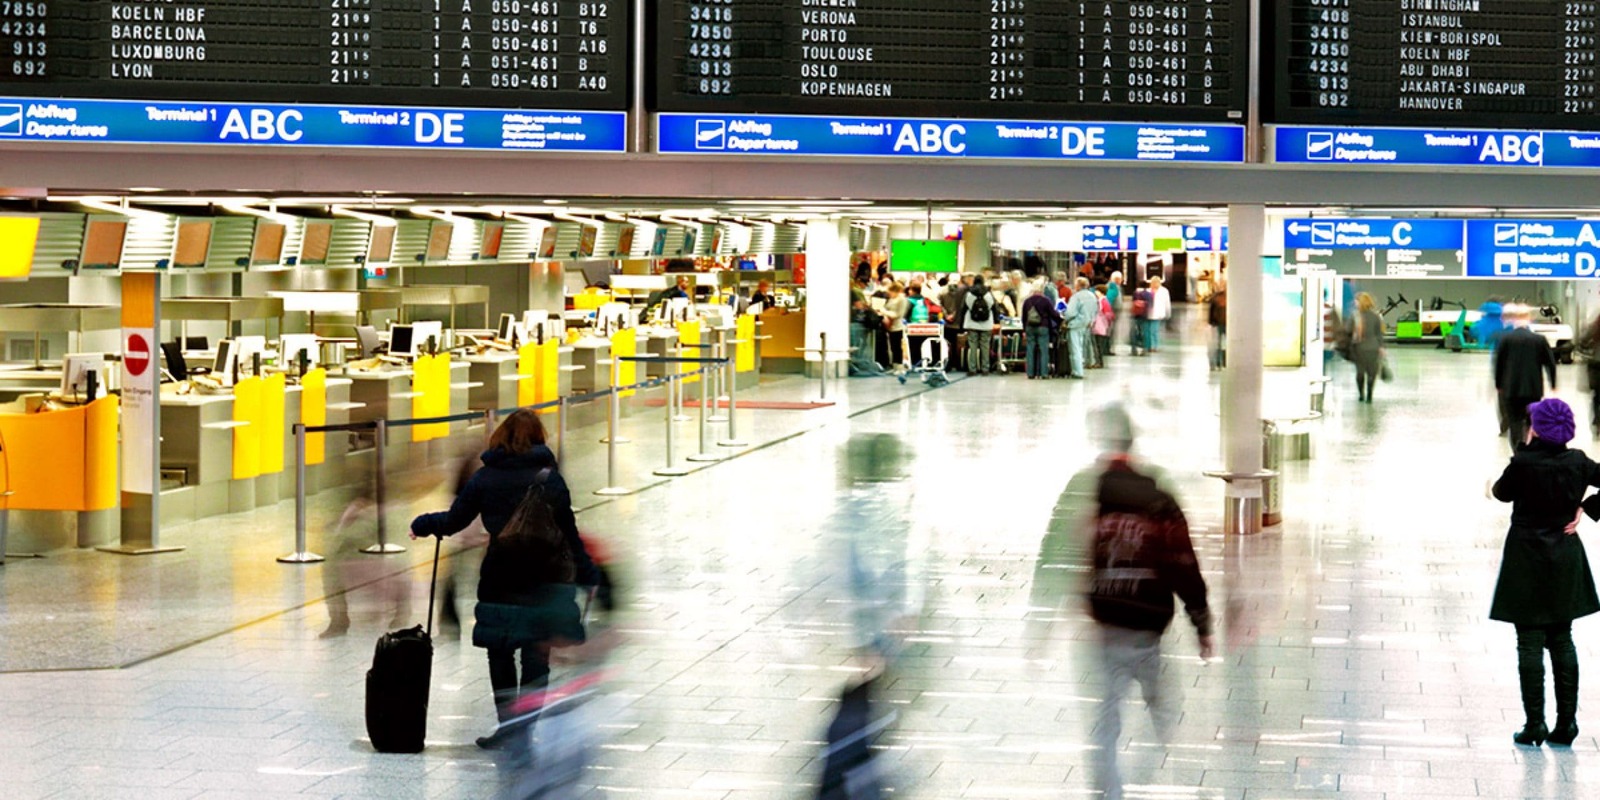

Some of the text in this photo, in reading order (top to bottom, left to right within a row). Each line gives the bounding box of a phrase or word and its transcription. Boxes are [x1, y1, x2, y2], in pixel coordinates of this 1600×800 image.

[3, 2, 46, 15] 7850
[112, 6, 163, 20] KOELN
[176, 8, 205, 22] HBF
[434, 17, 439, 29] 1
[462, 17, 471, 30] A
[492, 18, 557, 33] 050-461
[580, 21, 597, 35] T6
[435, 0, 439, 10] 1
[462, 0, 471, 11] A
[492, 1, 557, 15] 050-461
[580, 3, 607, 16] B12
[1080, 4, 1084, 14] 1
[1104, 4, 1111, 15] A
[1130, 5, 1186, 18] 050-461
[1205, 8, 1212, 19] A
[1321, 9, 1349, 23] 408
[1403, 14, 1462, 27] ISTANBUL
[691, 7, 732, 21] 3416
[802, 11, 855, 24] VERONA
[1080, 21, 1084, 32] 1
[1104, 21, 1111, 32] A
[1130, 22, 1185, 35] 050-461
[1205, 25, 1212, 36] A
[2, 22, 45, 36] 4234
[112, 25, 205, 40] BARCELONA
[434, 35, 439, 48] 1
[462, 36, 471, 48] A
[492, 37, 557, 51] 050-461
[579, 40, 606, 53] A16
[691, 25, 731, 39] 7850
[802, 28, 846, 42] PORTO
[1080, 38, 1084, 49] 1
[1104, 39, 1111, 49] A
[1129, 39, 1185, 52] 050-461
[1205, 42, 1212, 53] A
[1311, 26, 1348, 39] 3416
[1401, 31, 1501, 45] KIEW-BORISPOL
[14, 42, 46, 55] 913
[434, 54, 439, 66] 1
[461, 54, 470, 67] A
[492, 55, 557, 70] 051-461
[579, 58, 587, 71] B
[690, 43, 731, 57] 4234
[802, 46, 872, 60] TOULOUSE
[1079, 55, 1083, 66] 1
[1103, 56, 1111, 67] A
[1129, 57, 1185, 69] 050-461
[1205, 59, 1212, 70] A
[1311, 42, 1348, 56] 7850
[1401, 48, 1439, 59] KOELN
[1448, 49, 1469, 60] HBF
[13, 61, 45, 75] 692
[112, 63, 152, 77] LYON
[434, 72, 439, 85] 1
[461, 73, 470, 85] A
[492, 73, 557, 88] 050-461
[579, 76, 606, 89] A40
[701, 61, 731, 75] 913
[801, 64, 837, 77] OSLO
[1080, 72, 1083, 83] 1
[1103, 73, 1110, 84] A
[1129, 73, 1185, 86] 050-461
[1205, 76, 1211, 87] B
[1310, 60, 1347, 72] 4234
[1400, 64, 1423, 76] ABU
[1432, 65, 1469, 77] DHABI
[700, 79, 730, 93] 692
[801, 82, 891, 96] KOPENHAGEN
[1079, 90, 1083, 100] 1
[1103, 90, 1110, 101] A
[1129, 91, 1185, 103] 050-461
[1204, 93, 1211, 104] B
[1320, 76, 1348, 89] 913
[1401, 81, 1525, 95] JAKARTA-SINGAPUR
[1320, 93, 1347, 106] 692
[1400, 97, 1462, 109] HANNOVER
[26, 122, 107, 137] Departures
[146, 107, 302, 140] Terminal 1 ABC
[339, 111, 464, 143] Terminal 2 DE
[728, 136, 798, 150] Departures
[831, 122, 965, 153] Terminal 1 ABC
[997, 126, 1104, 155] Terminal 2 DE
[1425, 134, 1470, 145] Terminal
[1479, 135, 1541, 162] ABC
[1393, 222, 1411, 245] C
